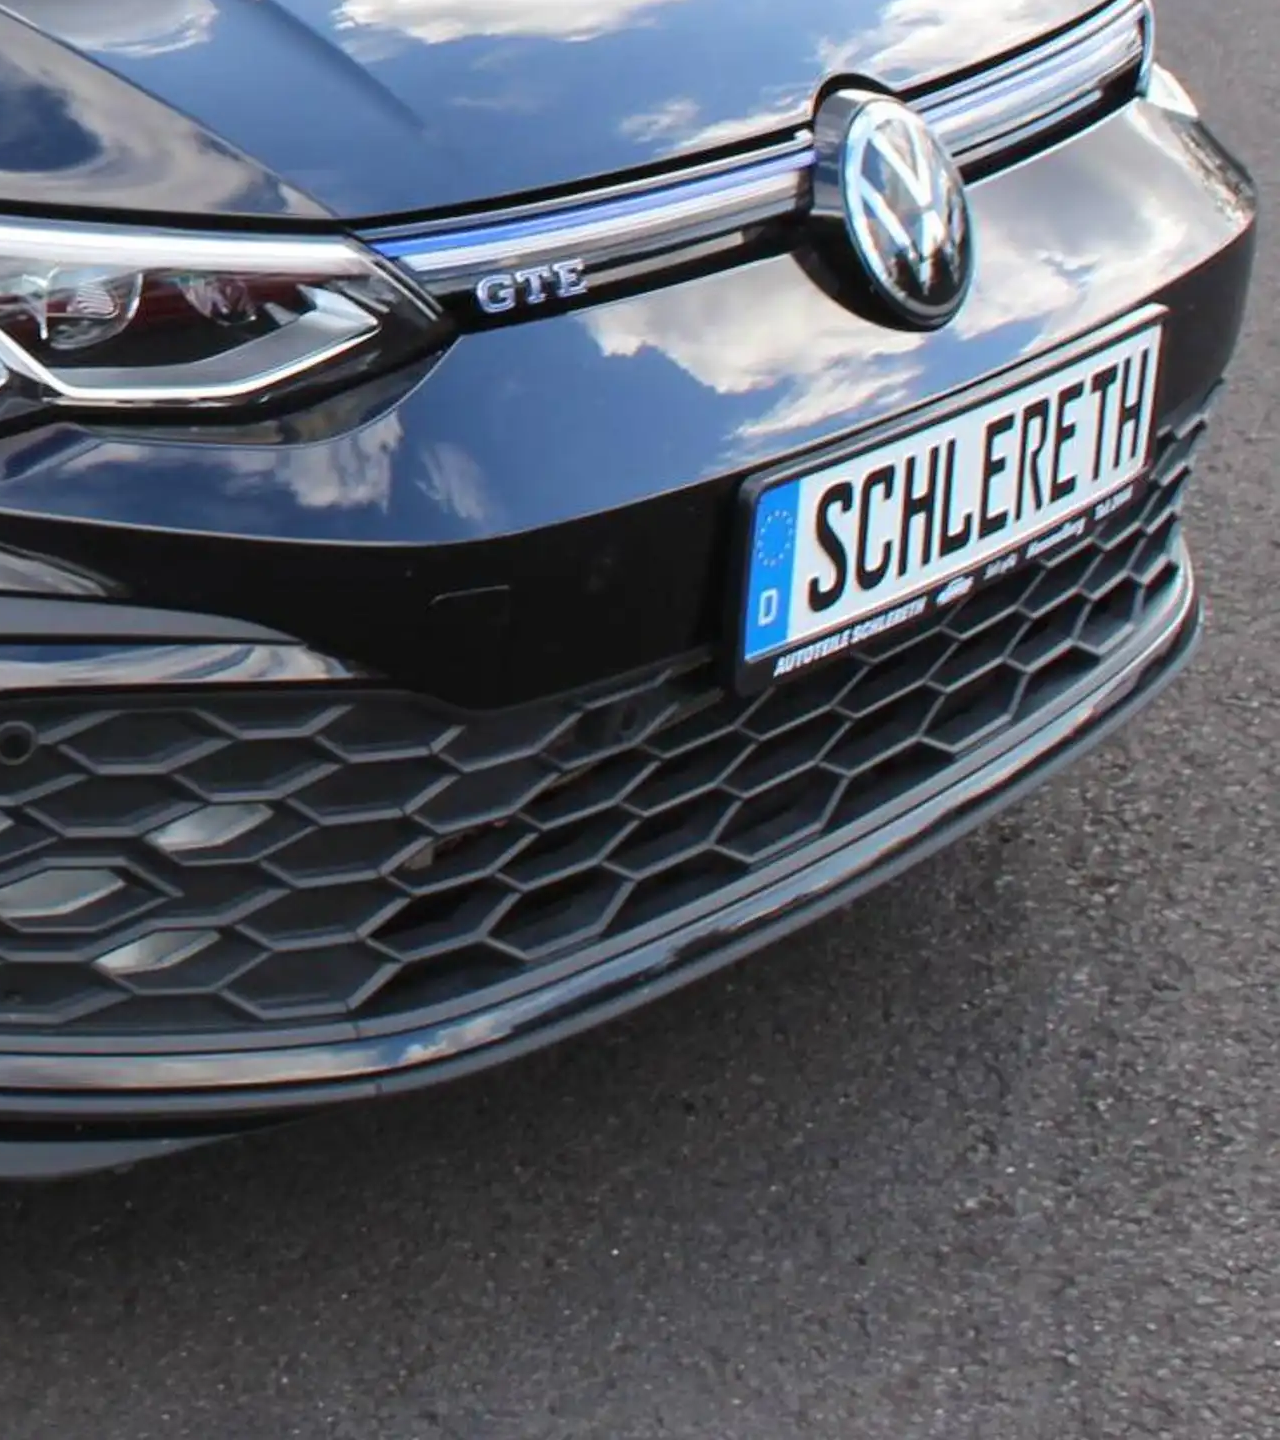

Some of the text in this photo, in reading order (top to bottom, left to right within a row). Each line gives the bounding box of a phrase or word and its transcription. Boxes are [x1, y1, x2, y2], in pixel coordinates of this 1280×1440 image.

[475, 259, 591, 316] GTE
[806, 346, 1151, 614] SCHLERETH
[757, 588, 779, 627] D
